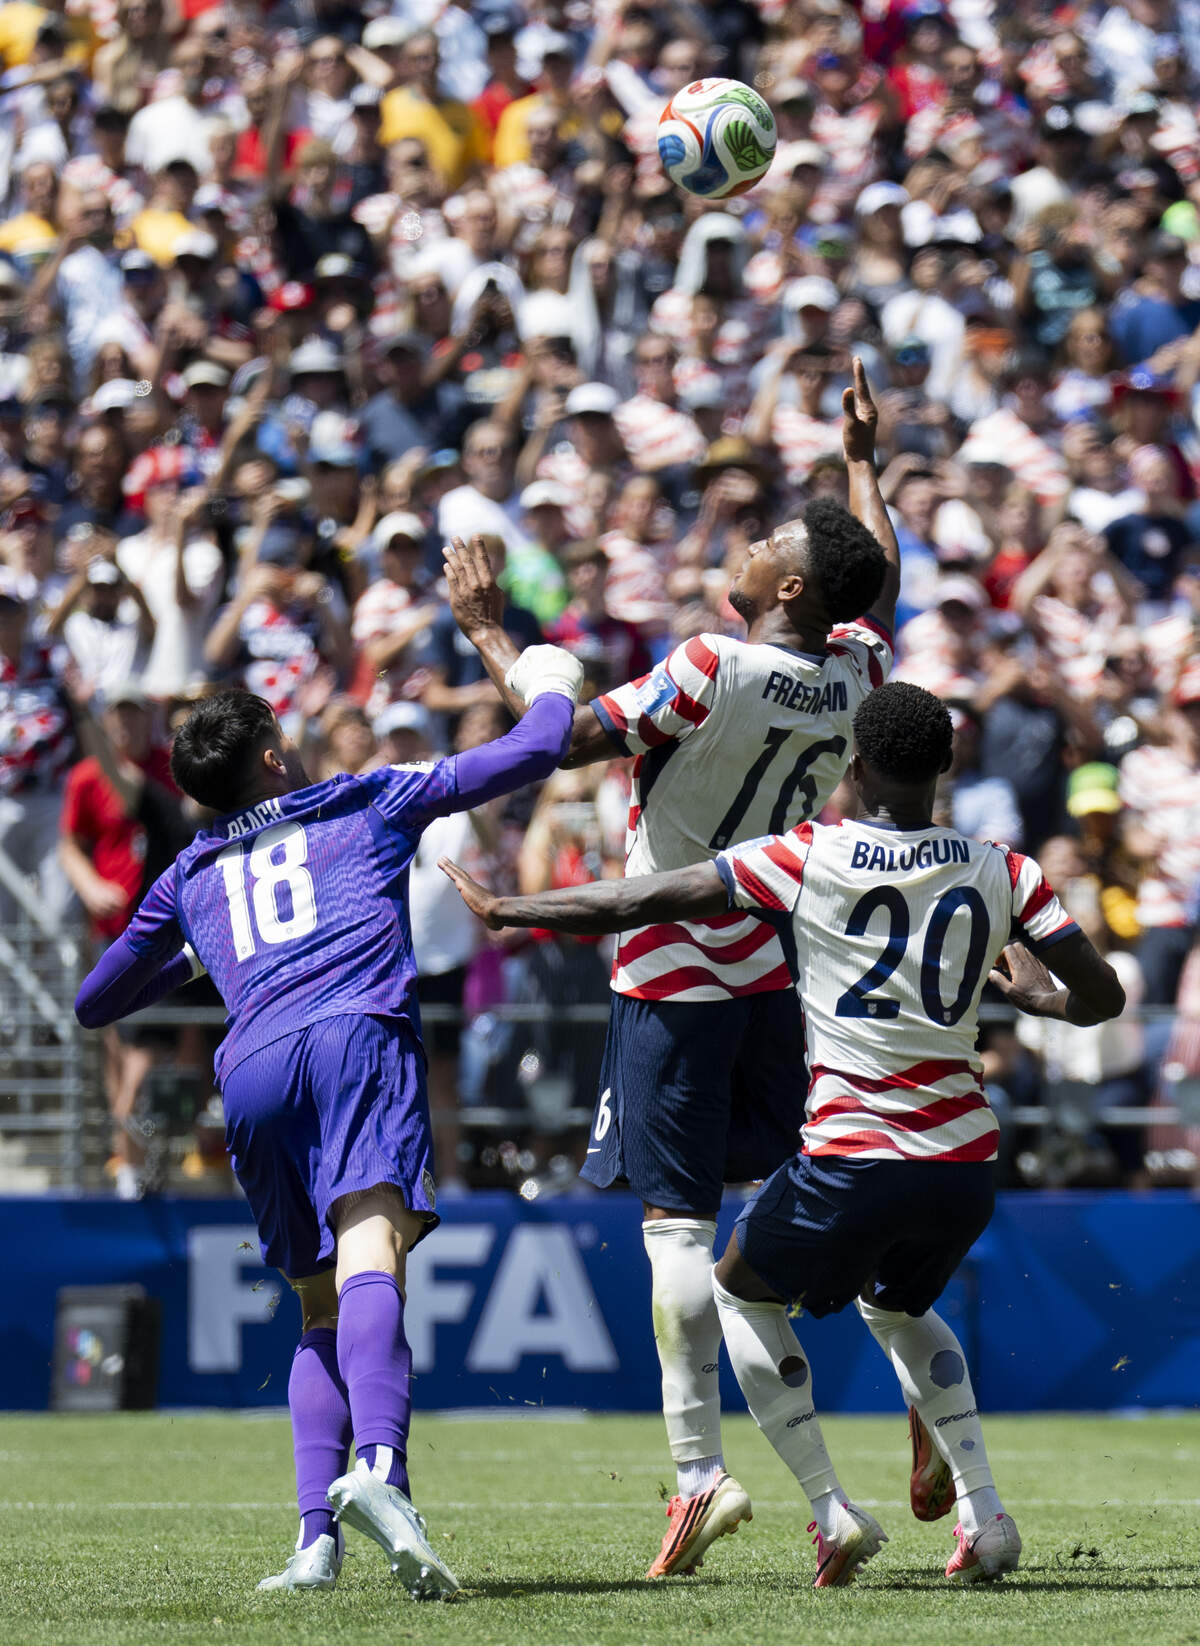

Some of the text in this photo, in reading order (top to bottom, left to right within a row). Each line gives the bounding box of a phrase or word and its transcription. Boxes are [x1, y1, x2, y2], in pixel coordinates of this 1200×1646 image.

[762, 671, 848, 715] FREEMAN
[709, 727, 847, 849] 16
[215, 821, 318, 962] 18
[851, 839, 970, 871] BALOGUN
[835, 885, 990, 1027] 20
[594, 1087, 612, 1141] 6
[189, 1223, 618, 1373] FFA
